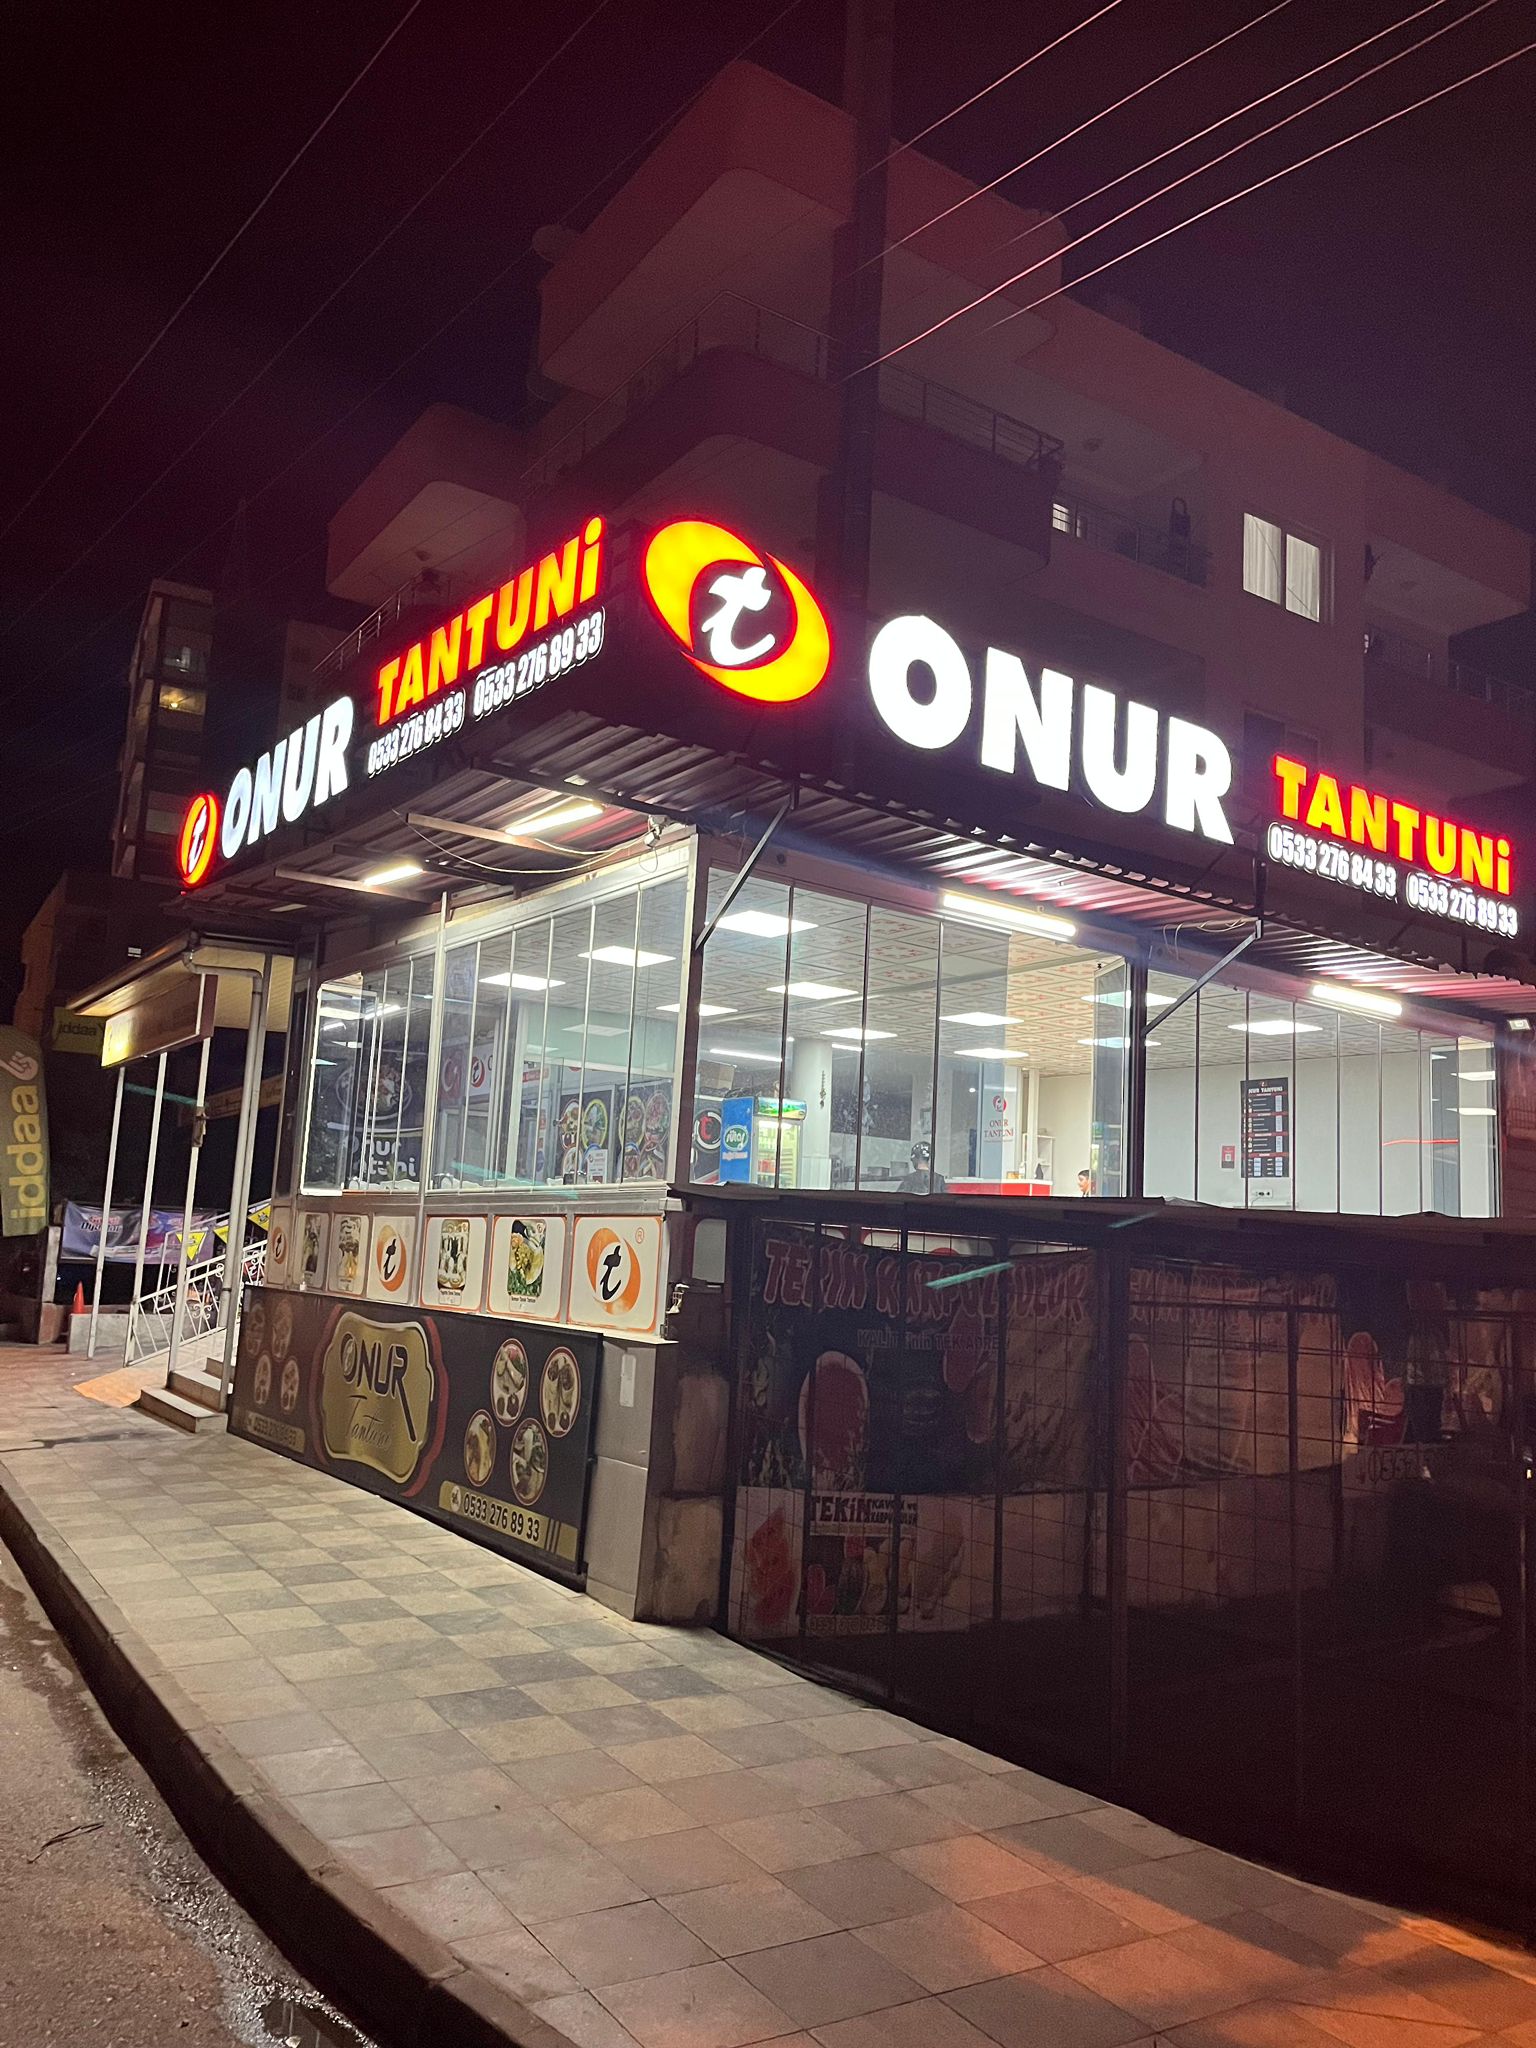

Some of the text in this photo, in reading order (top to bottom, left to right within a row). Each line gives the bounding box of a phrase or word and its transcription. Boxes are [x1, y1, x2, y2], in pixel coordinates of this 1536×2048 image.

[472, 611, 603, 717] 0533 276 89 33
[220, 694, 355, 859] ONUR
[367, 691, 465, 775] 0533 276 84 33
[869, 614, 1234, 845] ONUR
[1270, 825, 1398, 899] 0533 276 84 33
[1407, 872, 1519, 938] 0533 276 89 33
[6, 1085, 46, 1221] iddaa
[340, 1332, 417, 1442] ONUR
[463, 1492, 540, 1542] 0533 276 89 33
